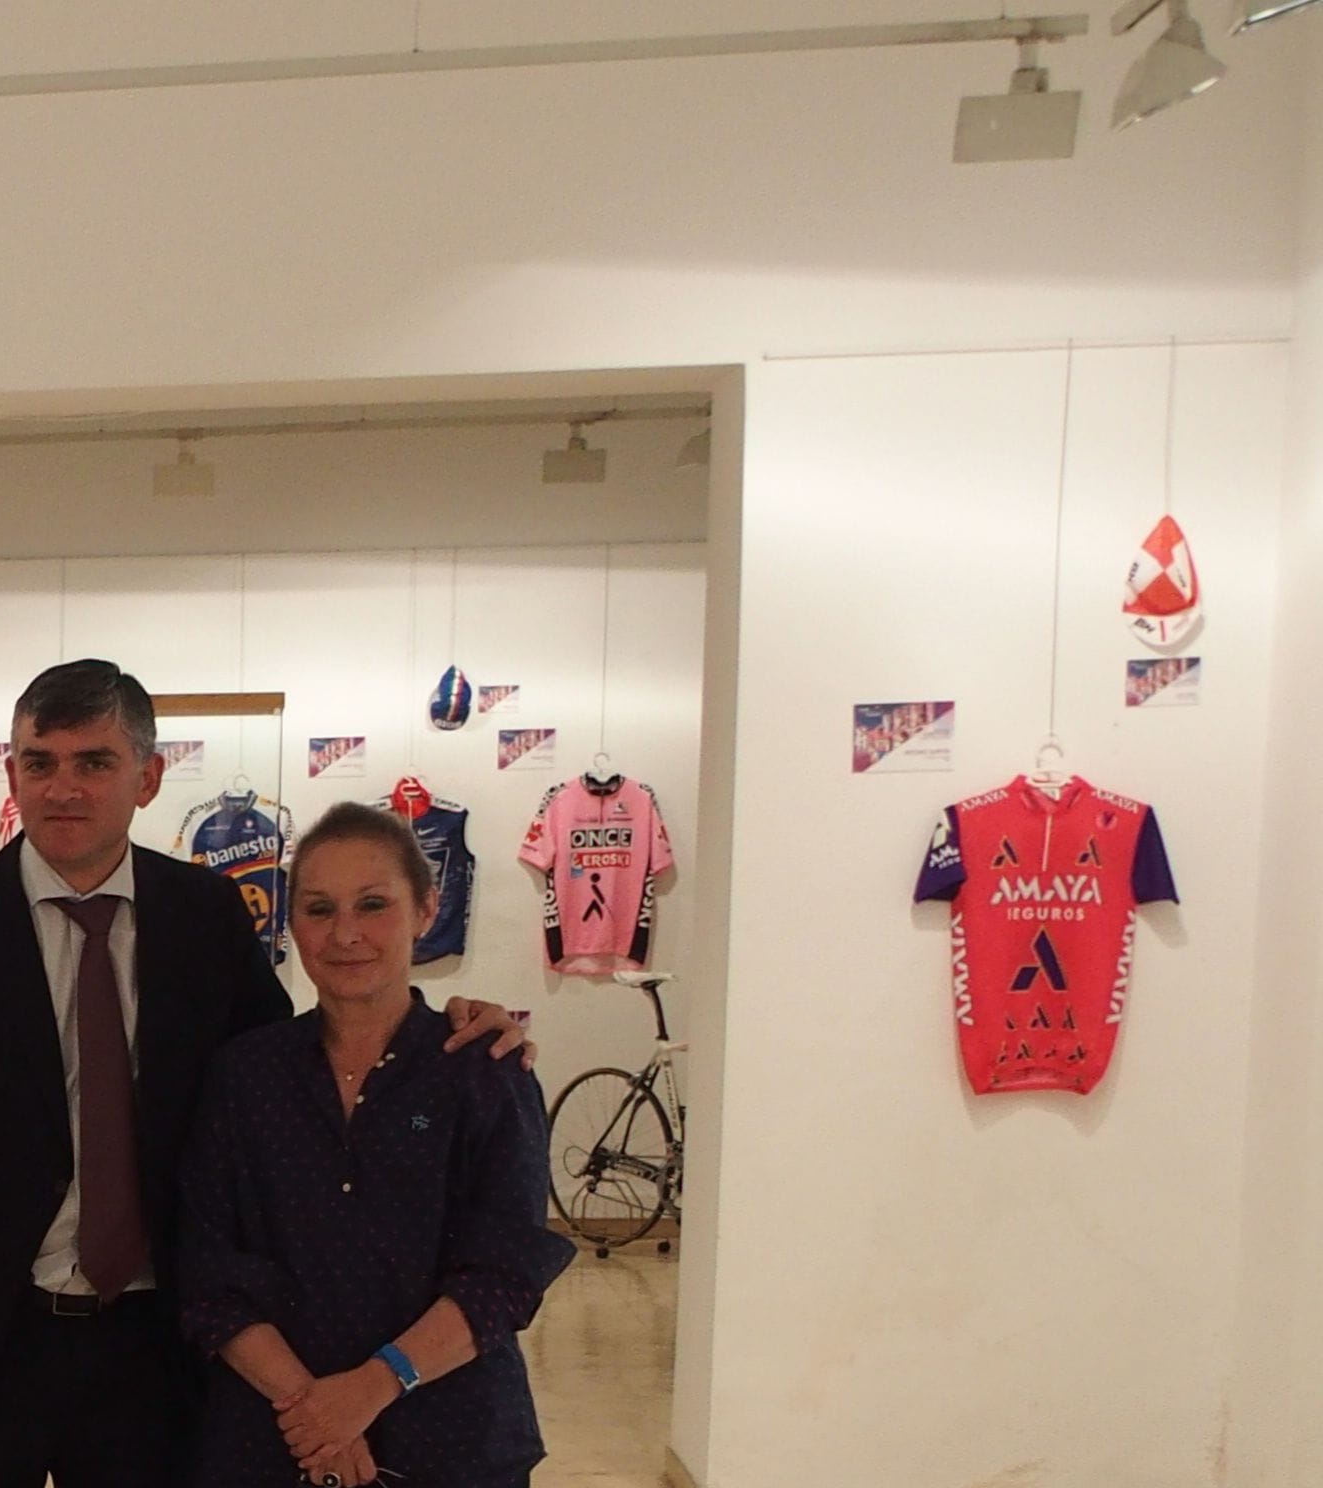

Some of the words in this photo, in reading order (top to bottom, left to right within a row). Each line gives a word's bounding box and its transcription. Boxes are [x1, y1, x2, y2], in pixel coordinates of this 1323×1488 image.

[961, 788, 1009, 812] AMAYA
[1092, 788, 1140, 814] AMAYA
[206, 834, 277, 868] banesto
[571, 828, 633, 849] ONCE
[582, 852, 631, 869] EROSKI
[544, 872, 559, 928] ERO
[990, 874, 1103, 905] AMAYA
